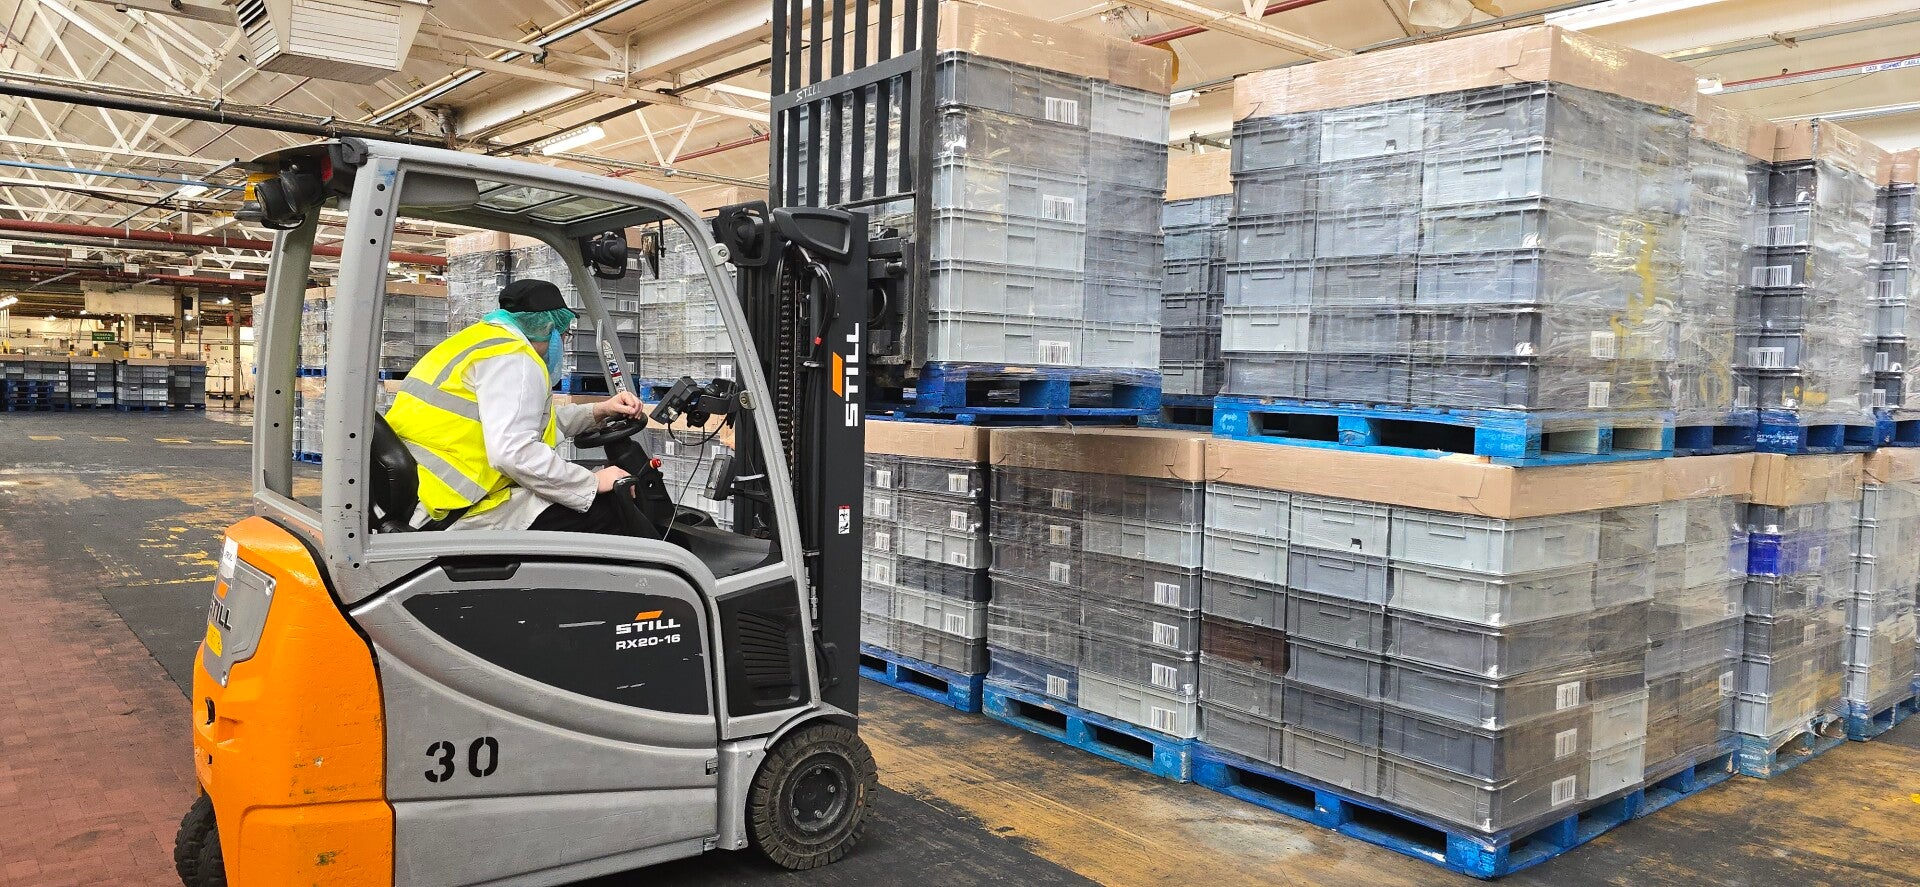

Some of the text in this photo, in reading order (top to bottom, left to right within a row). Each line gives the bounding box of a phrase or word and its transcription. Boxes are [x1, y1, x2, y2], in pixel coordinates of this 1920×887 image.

[795, 84, 821, 102] STILL
[845, 322, 859, 427] STILL
[616, 618, 681, 635] STILL
[616, 634, 681, 650] RX20-16
[424, 736, 499, 783] 30
